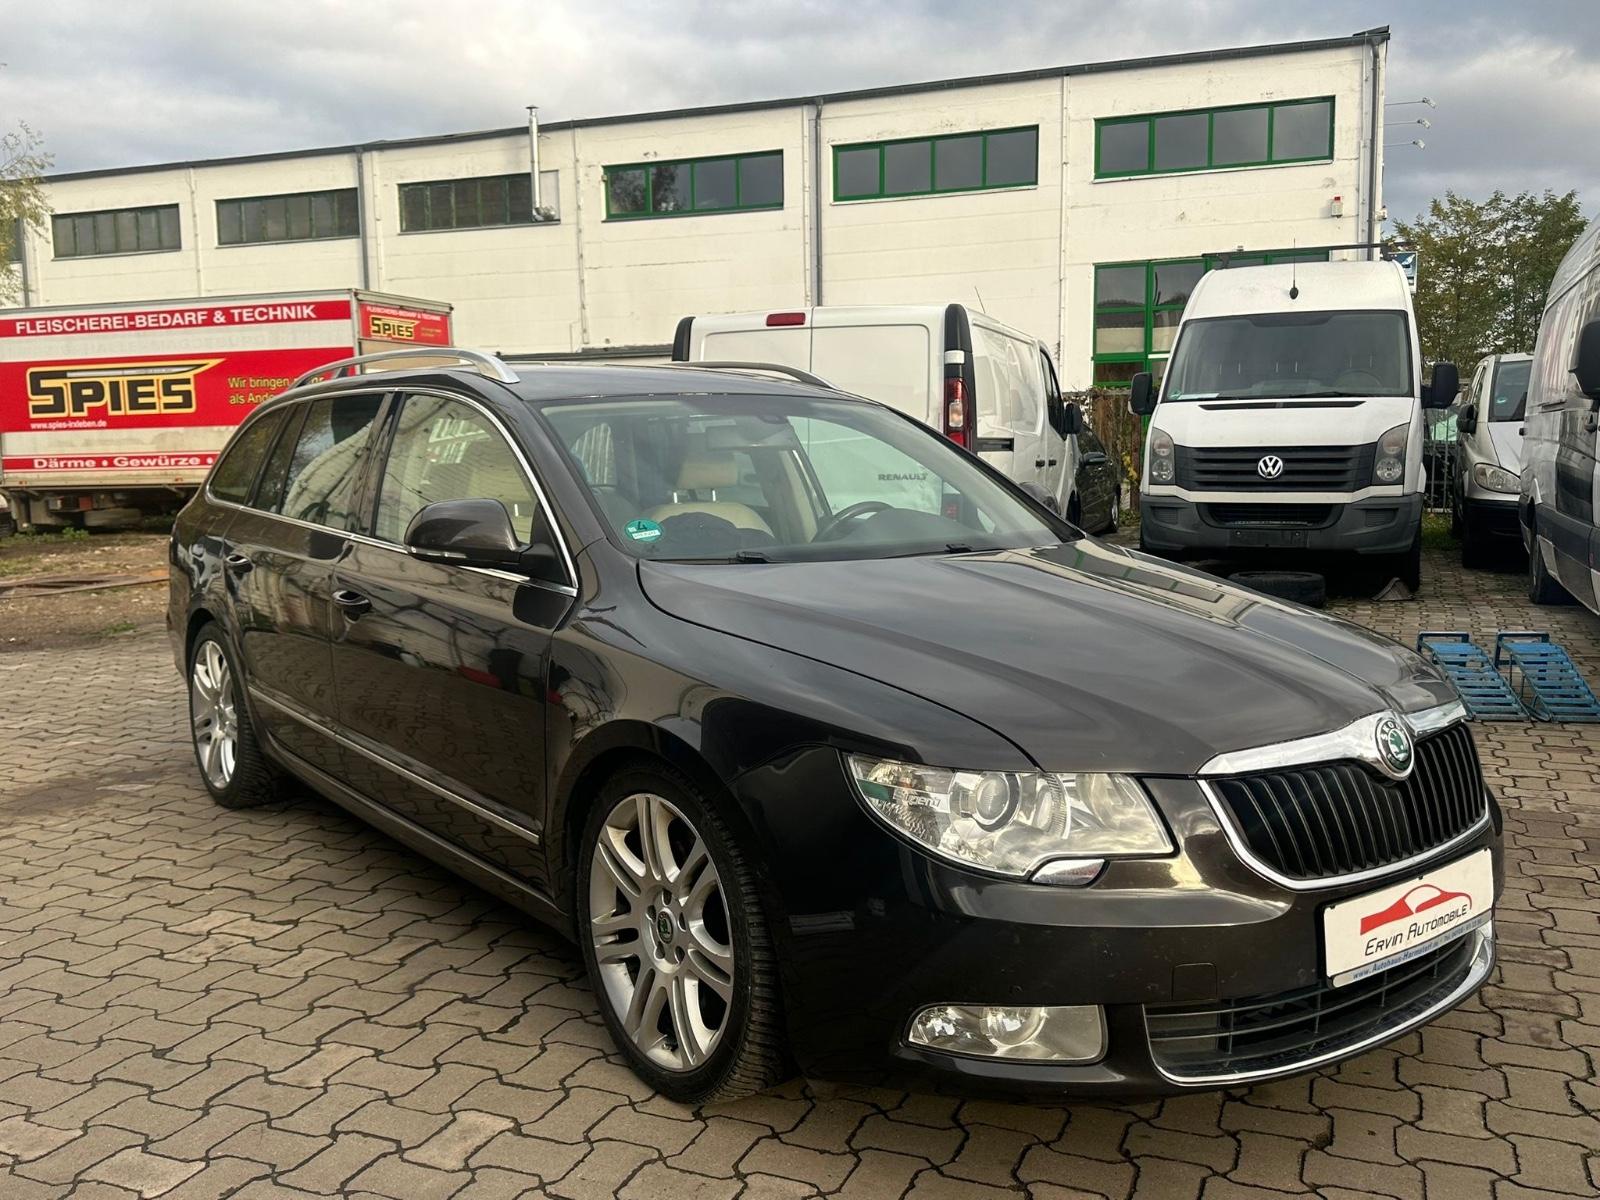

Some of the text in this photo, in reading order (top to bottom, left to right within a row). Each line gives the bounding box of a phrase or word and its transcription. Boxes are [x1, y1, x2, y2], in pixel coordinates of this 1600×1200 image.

[16, 304, 317, 335] FLEISCHEREI-BEDARF & TECHNIK
[370, 315, 415, 339] SPIES
[228, 377, 246, 388] Wir
[249, 377, 290, 390] bringen
[28, 366, 197, 418] SPIES
[229, 393, 245, 404] als
[33, 455, 201, 469] Därme Gewürze
[878, 473, 928, 481] RENAULT
[637, 521, 648, 531] 4
[1364, 933, 1403, 957] ERVIN
[1407, 904, 1468, 940] AUTOMOBILE
